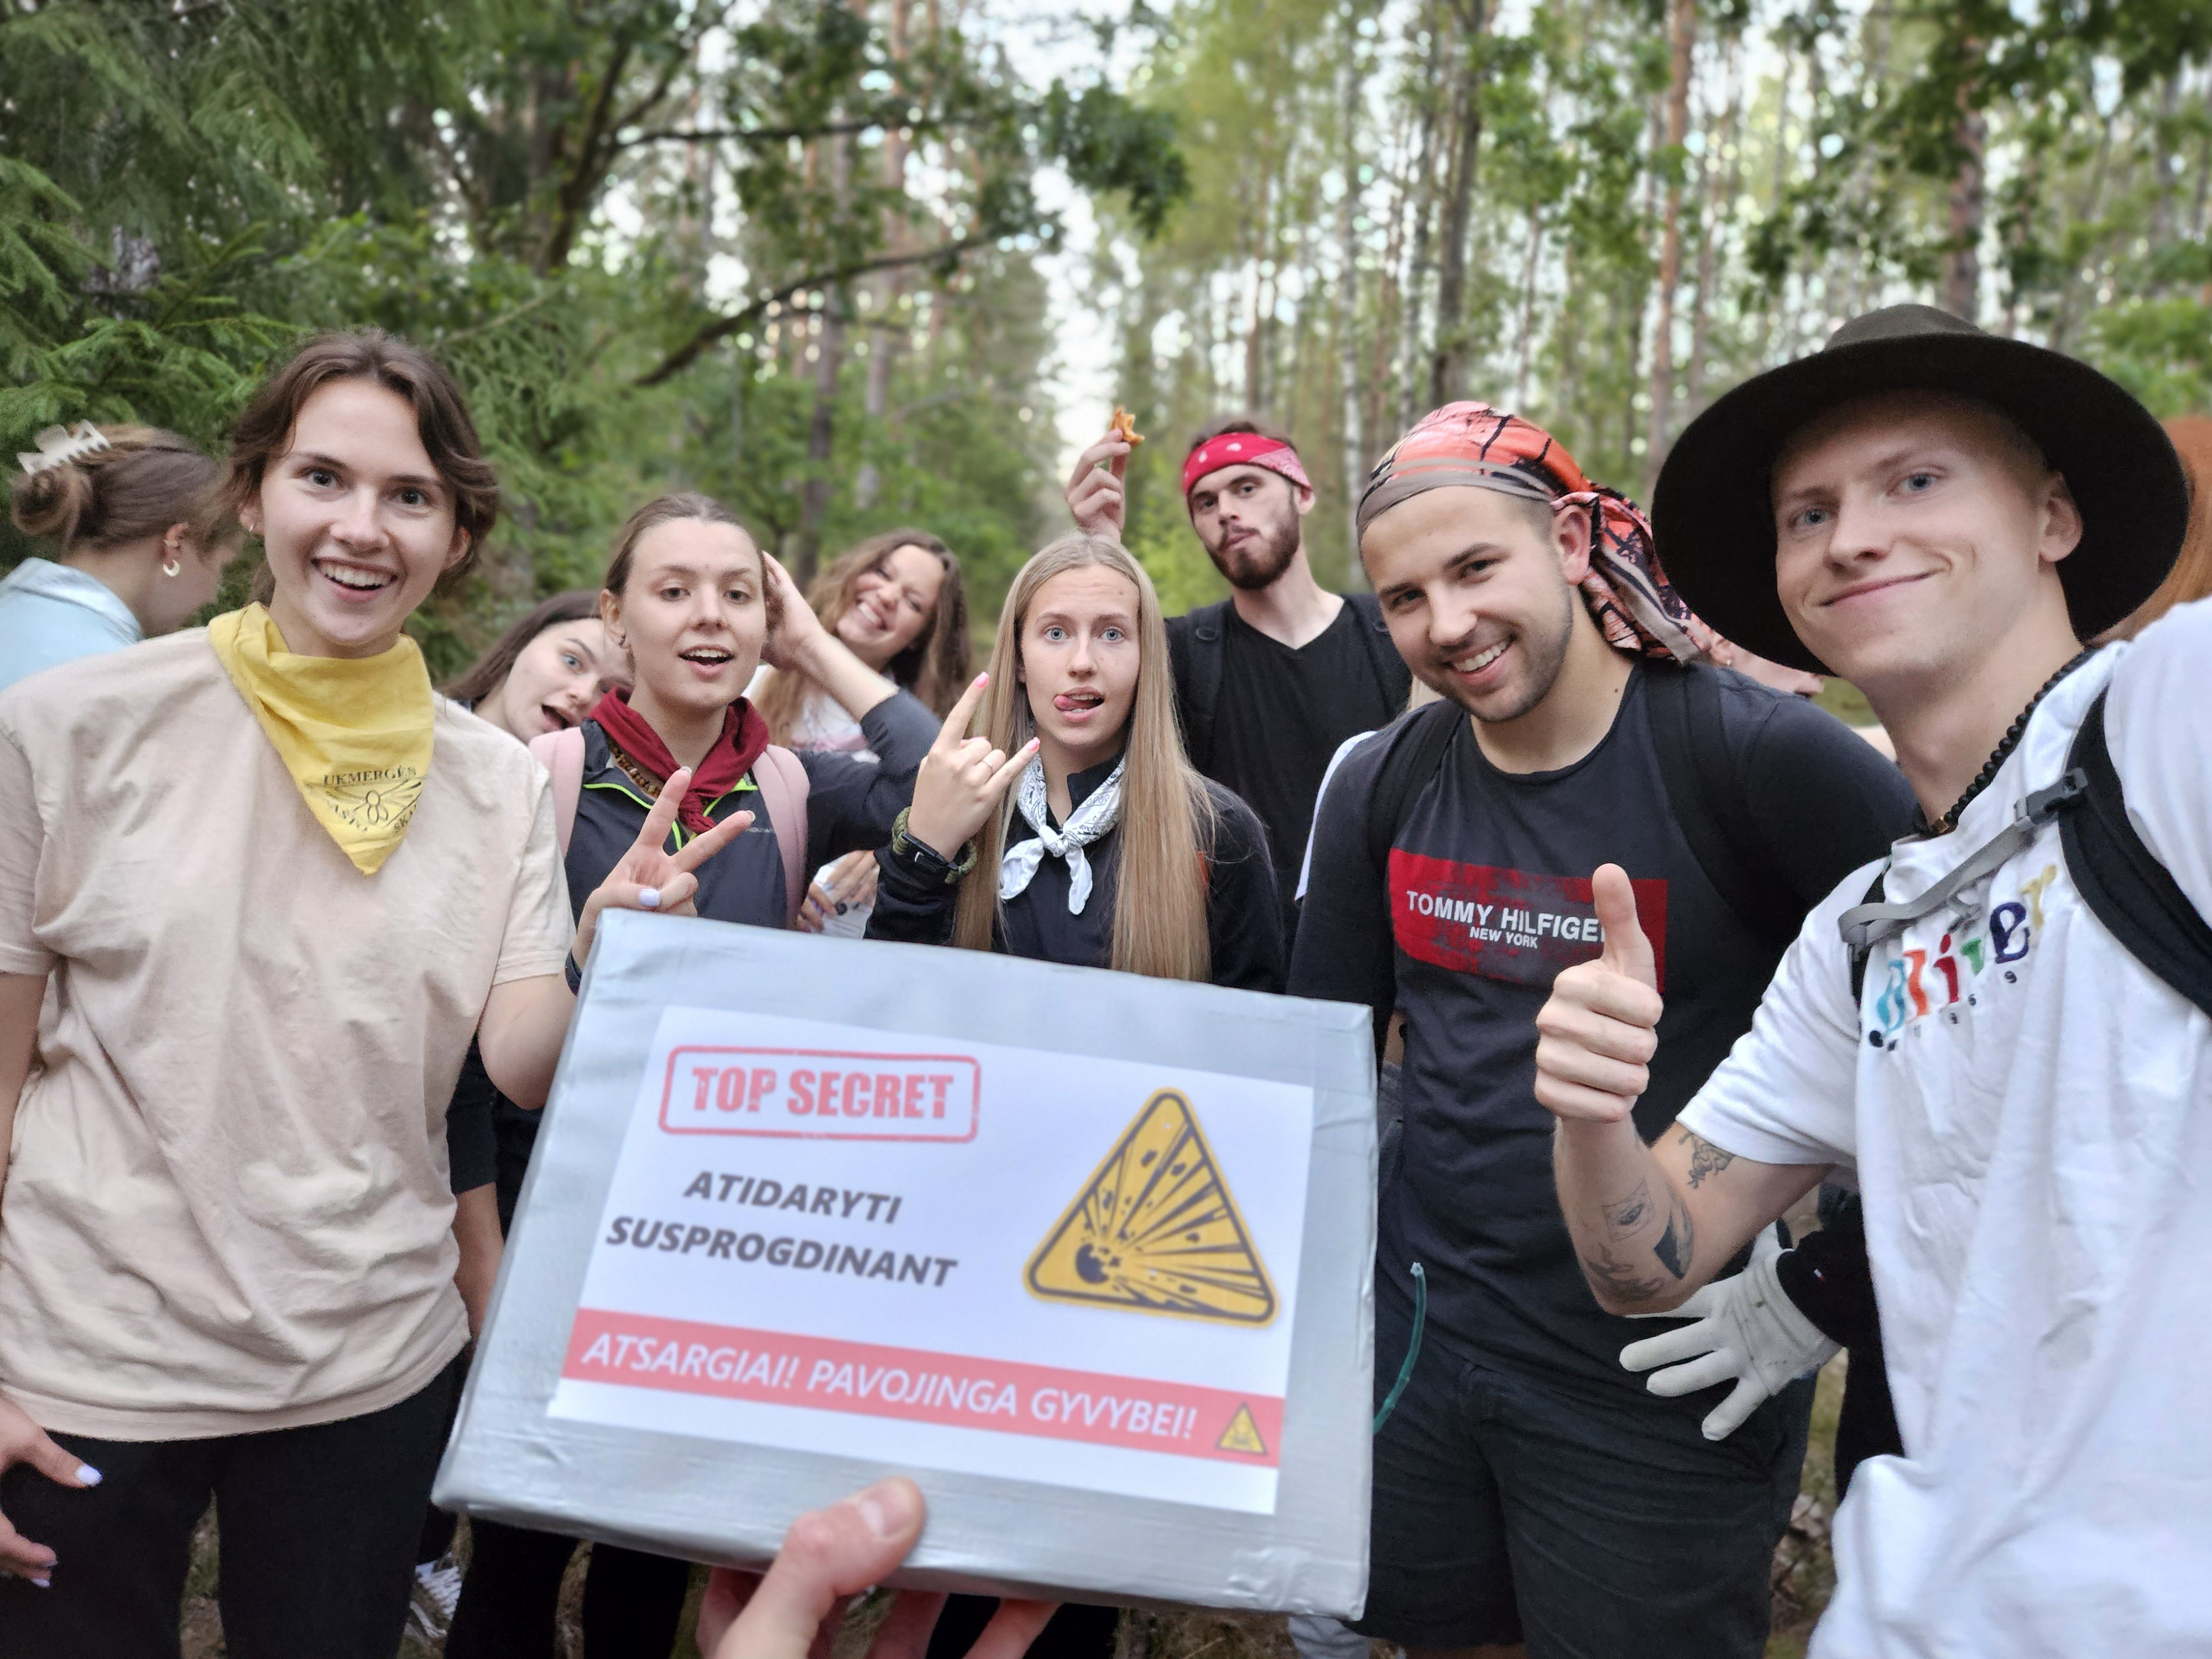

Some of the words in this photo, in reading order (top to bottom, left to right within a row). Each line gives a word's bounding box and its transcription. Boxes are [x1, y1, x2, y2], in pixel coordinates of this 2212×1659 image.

[1406, 890, 1494, 926] TOMMY
[1500, 907, 1605, 943] HILFIGE
[1469, 926, 1502, 942] NEW
[1505, 932, 1538, 949] YORK
[692, 1066, 777, 1113] TOP
[786, 1069, 953, 1119] SECRET
[682, 1171, 903, 1224] ATIDARYTI
[606, 1215, 958, 1287] SUSPROGDINANT
[581, 1332, 800, 1389] ATSARGIAI!
[806, 1358, 1018, 1417] PAVOJINGA
[1030, 1387, 1197, 1440] GYVYBEI!
